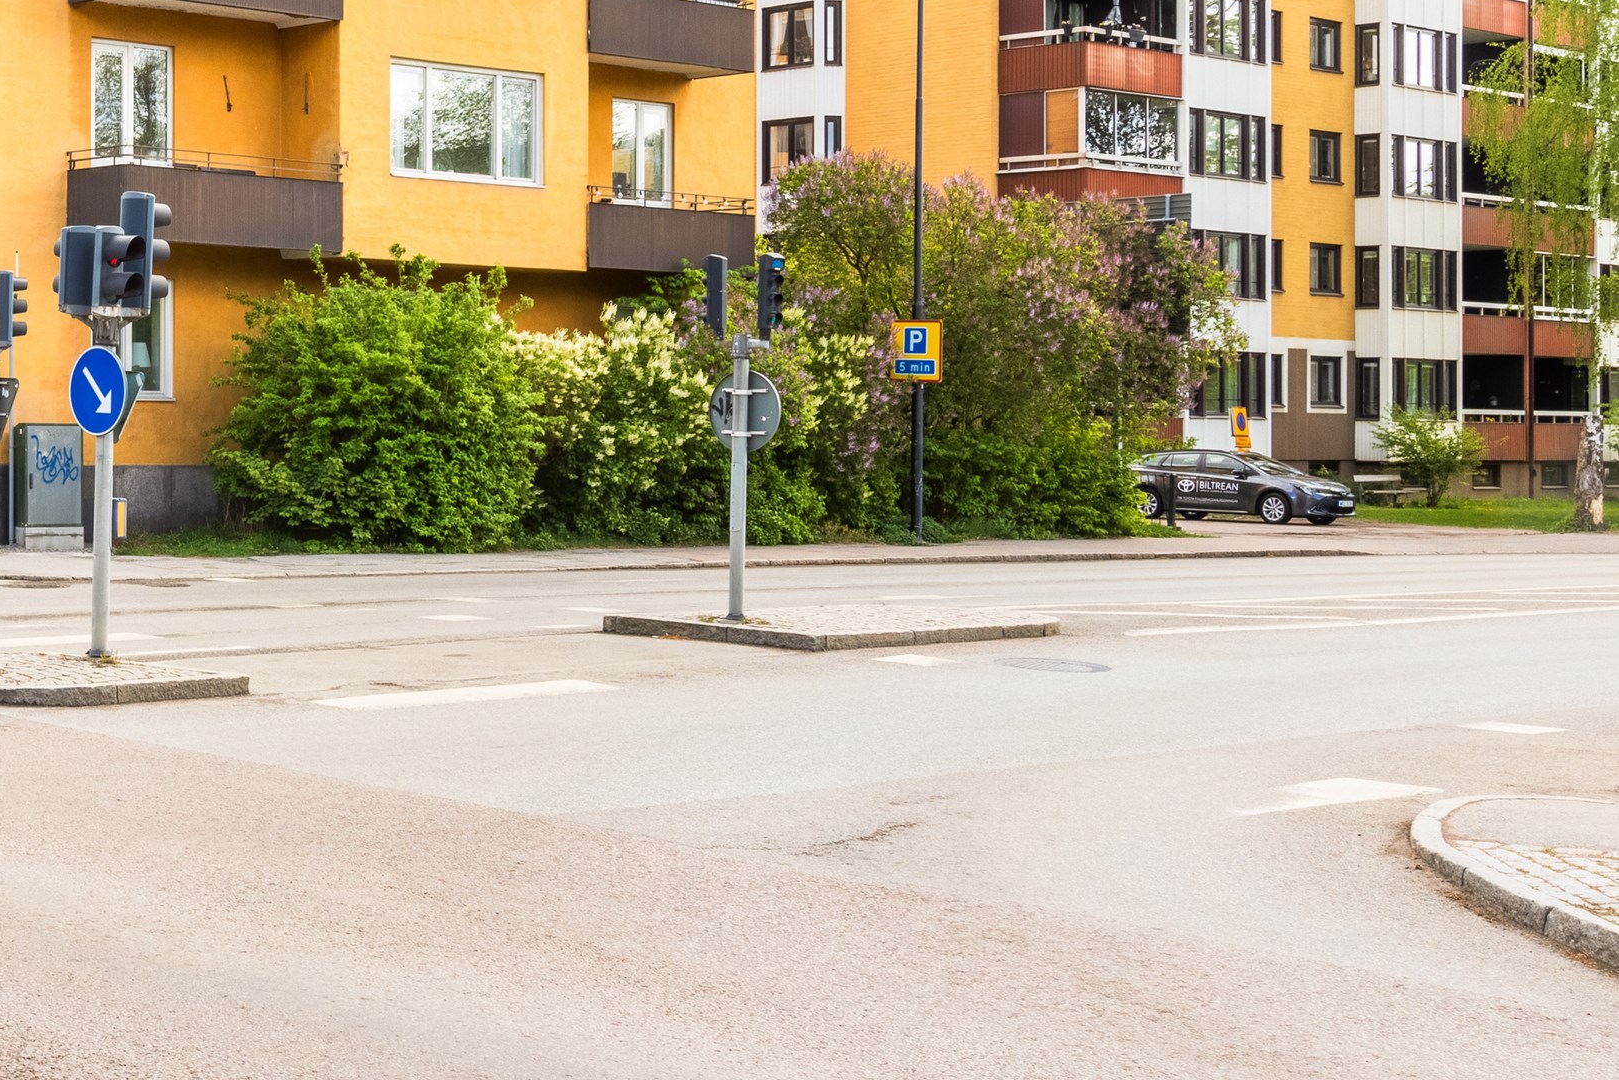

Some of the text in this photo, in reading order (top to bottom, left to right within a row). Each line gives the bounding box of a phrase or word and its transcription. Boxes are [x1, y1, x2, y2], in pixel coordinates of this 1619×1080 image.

[910, 330, 923, 351] P
[899, 361, 930, 372] 5 min
[1199, 480, 1239, 491] BILTREAN
